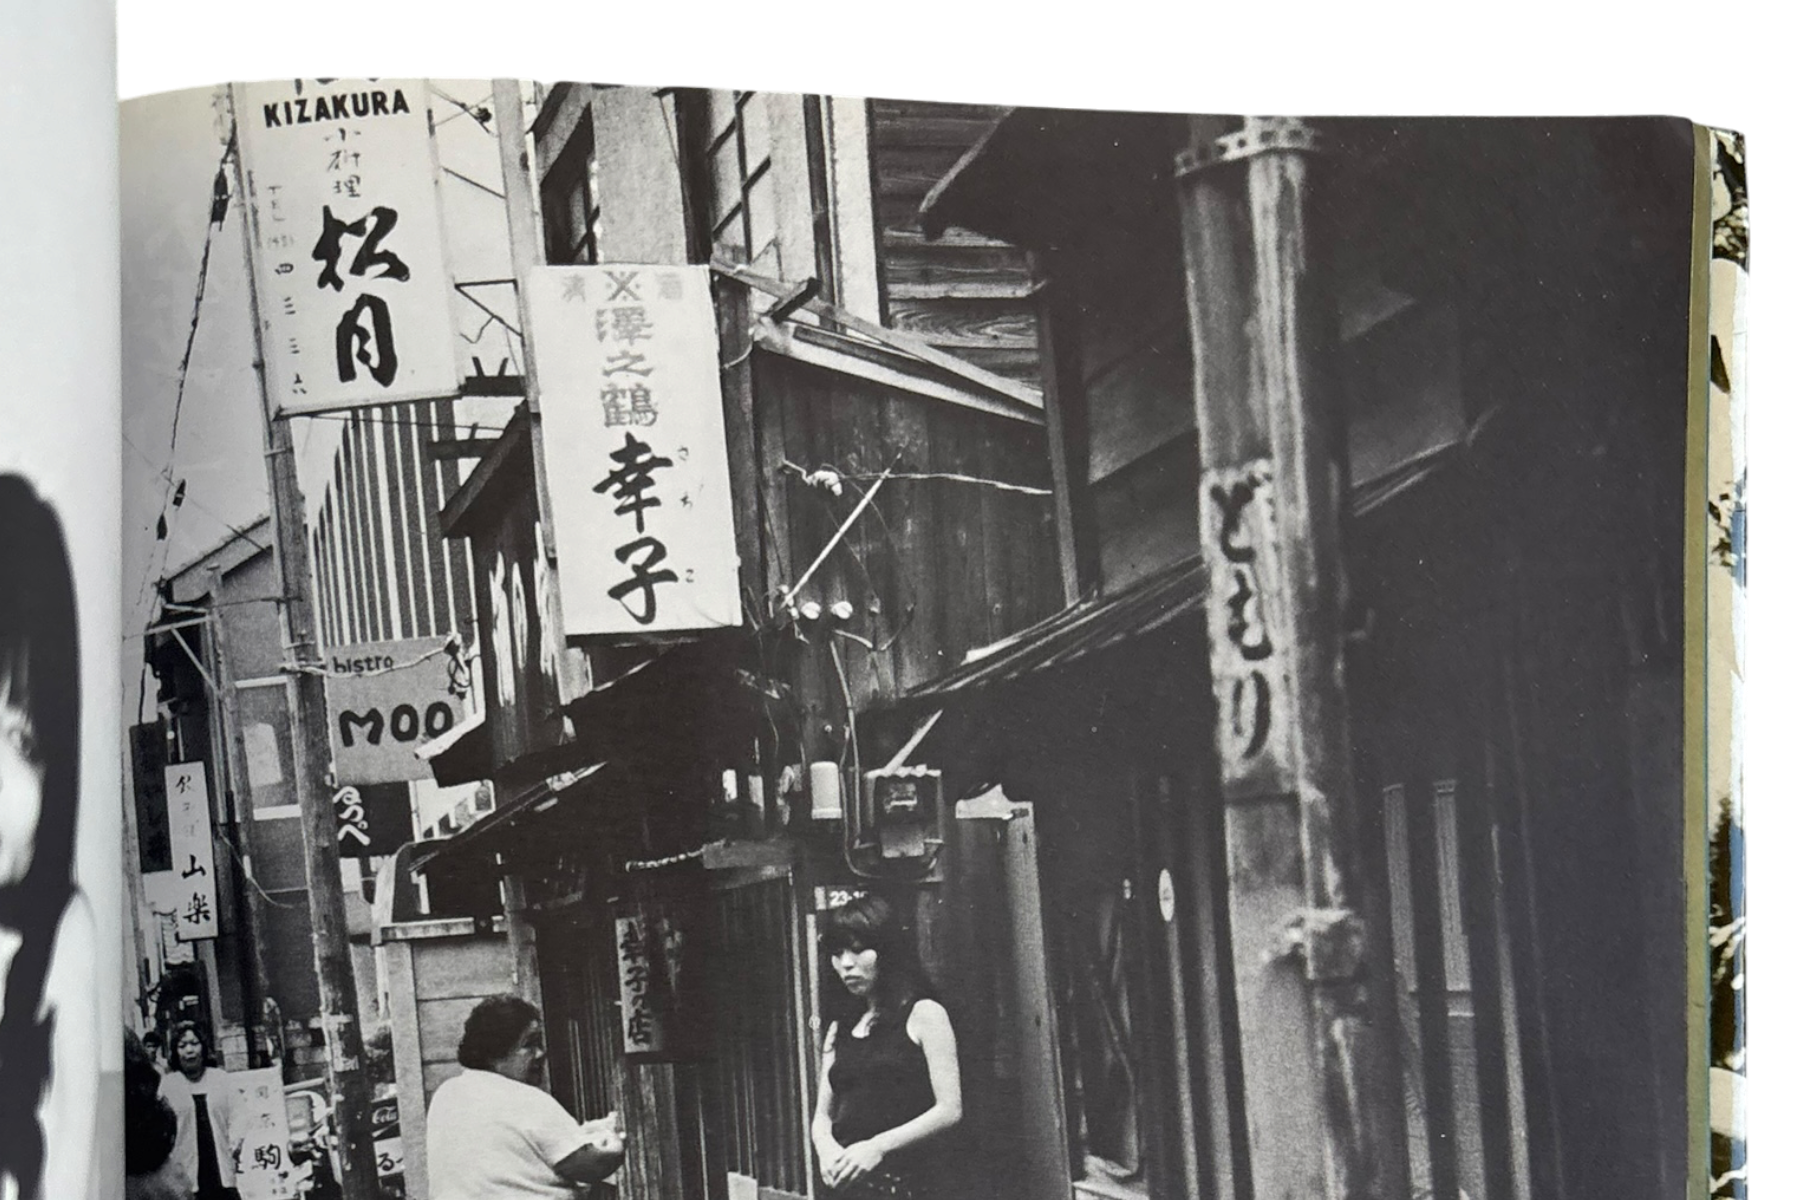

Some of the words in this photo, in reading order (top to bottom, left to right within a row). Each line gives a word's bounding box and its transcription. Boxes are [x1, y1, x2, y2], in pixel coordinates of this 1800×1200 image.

[263, 89, 410, 128] KIZAKURA
[322, 127, 362, 198] 小料理
[312, 205, 410, 388] 松月
[596, 305, 659, 427] 澤之鶴
[592, 431, 679, 625] 幸子
[334, 655, 394, 674] bistro
[339, 701, 454, 747] MOO
